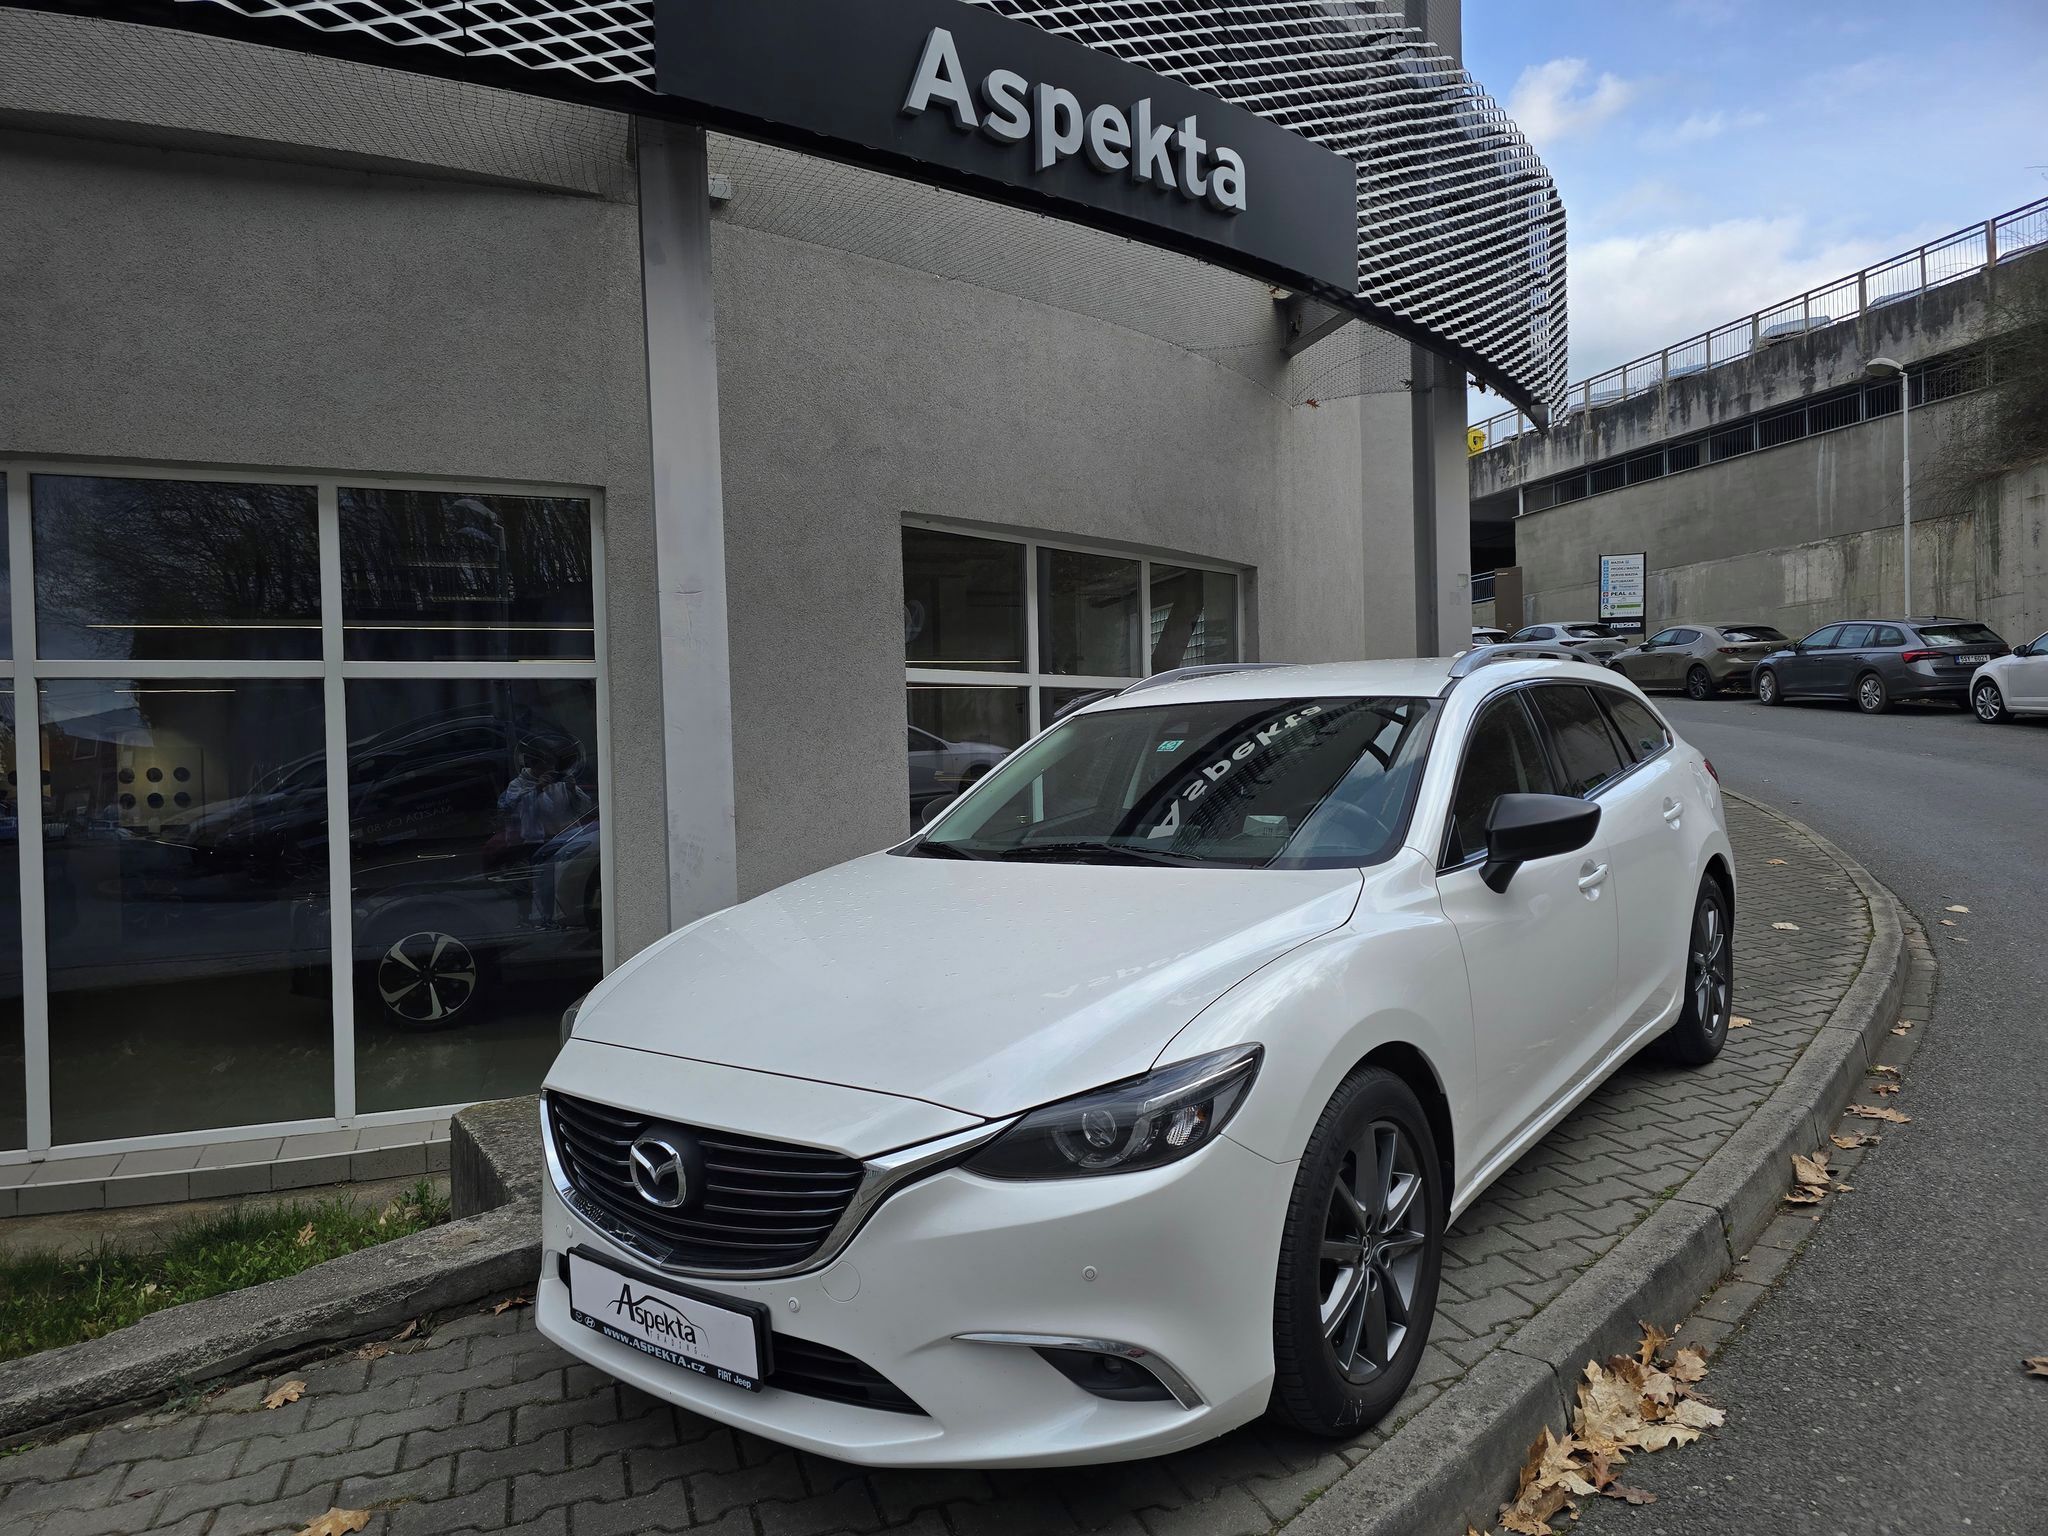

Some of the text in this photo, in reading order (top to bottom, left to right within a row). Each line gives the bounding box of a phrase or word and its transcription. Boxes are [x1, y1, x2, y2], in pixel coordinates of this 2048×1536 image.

[902, 26, 1247, 214] Aspekta
[616, 1283, 697, 1345] Aspekta
[603, 1325, 707, 1374] www.ASPEKTA.cz
[717, 1368, 732, 1383] FIAT
[733, 1375, 752, 1391] Jeep
